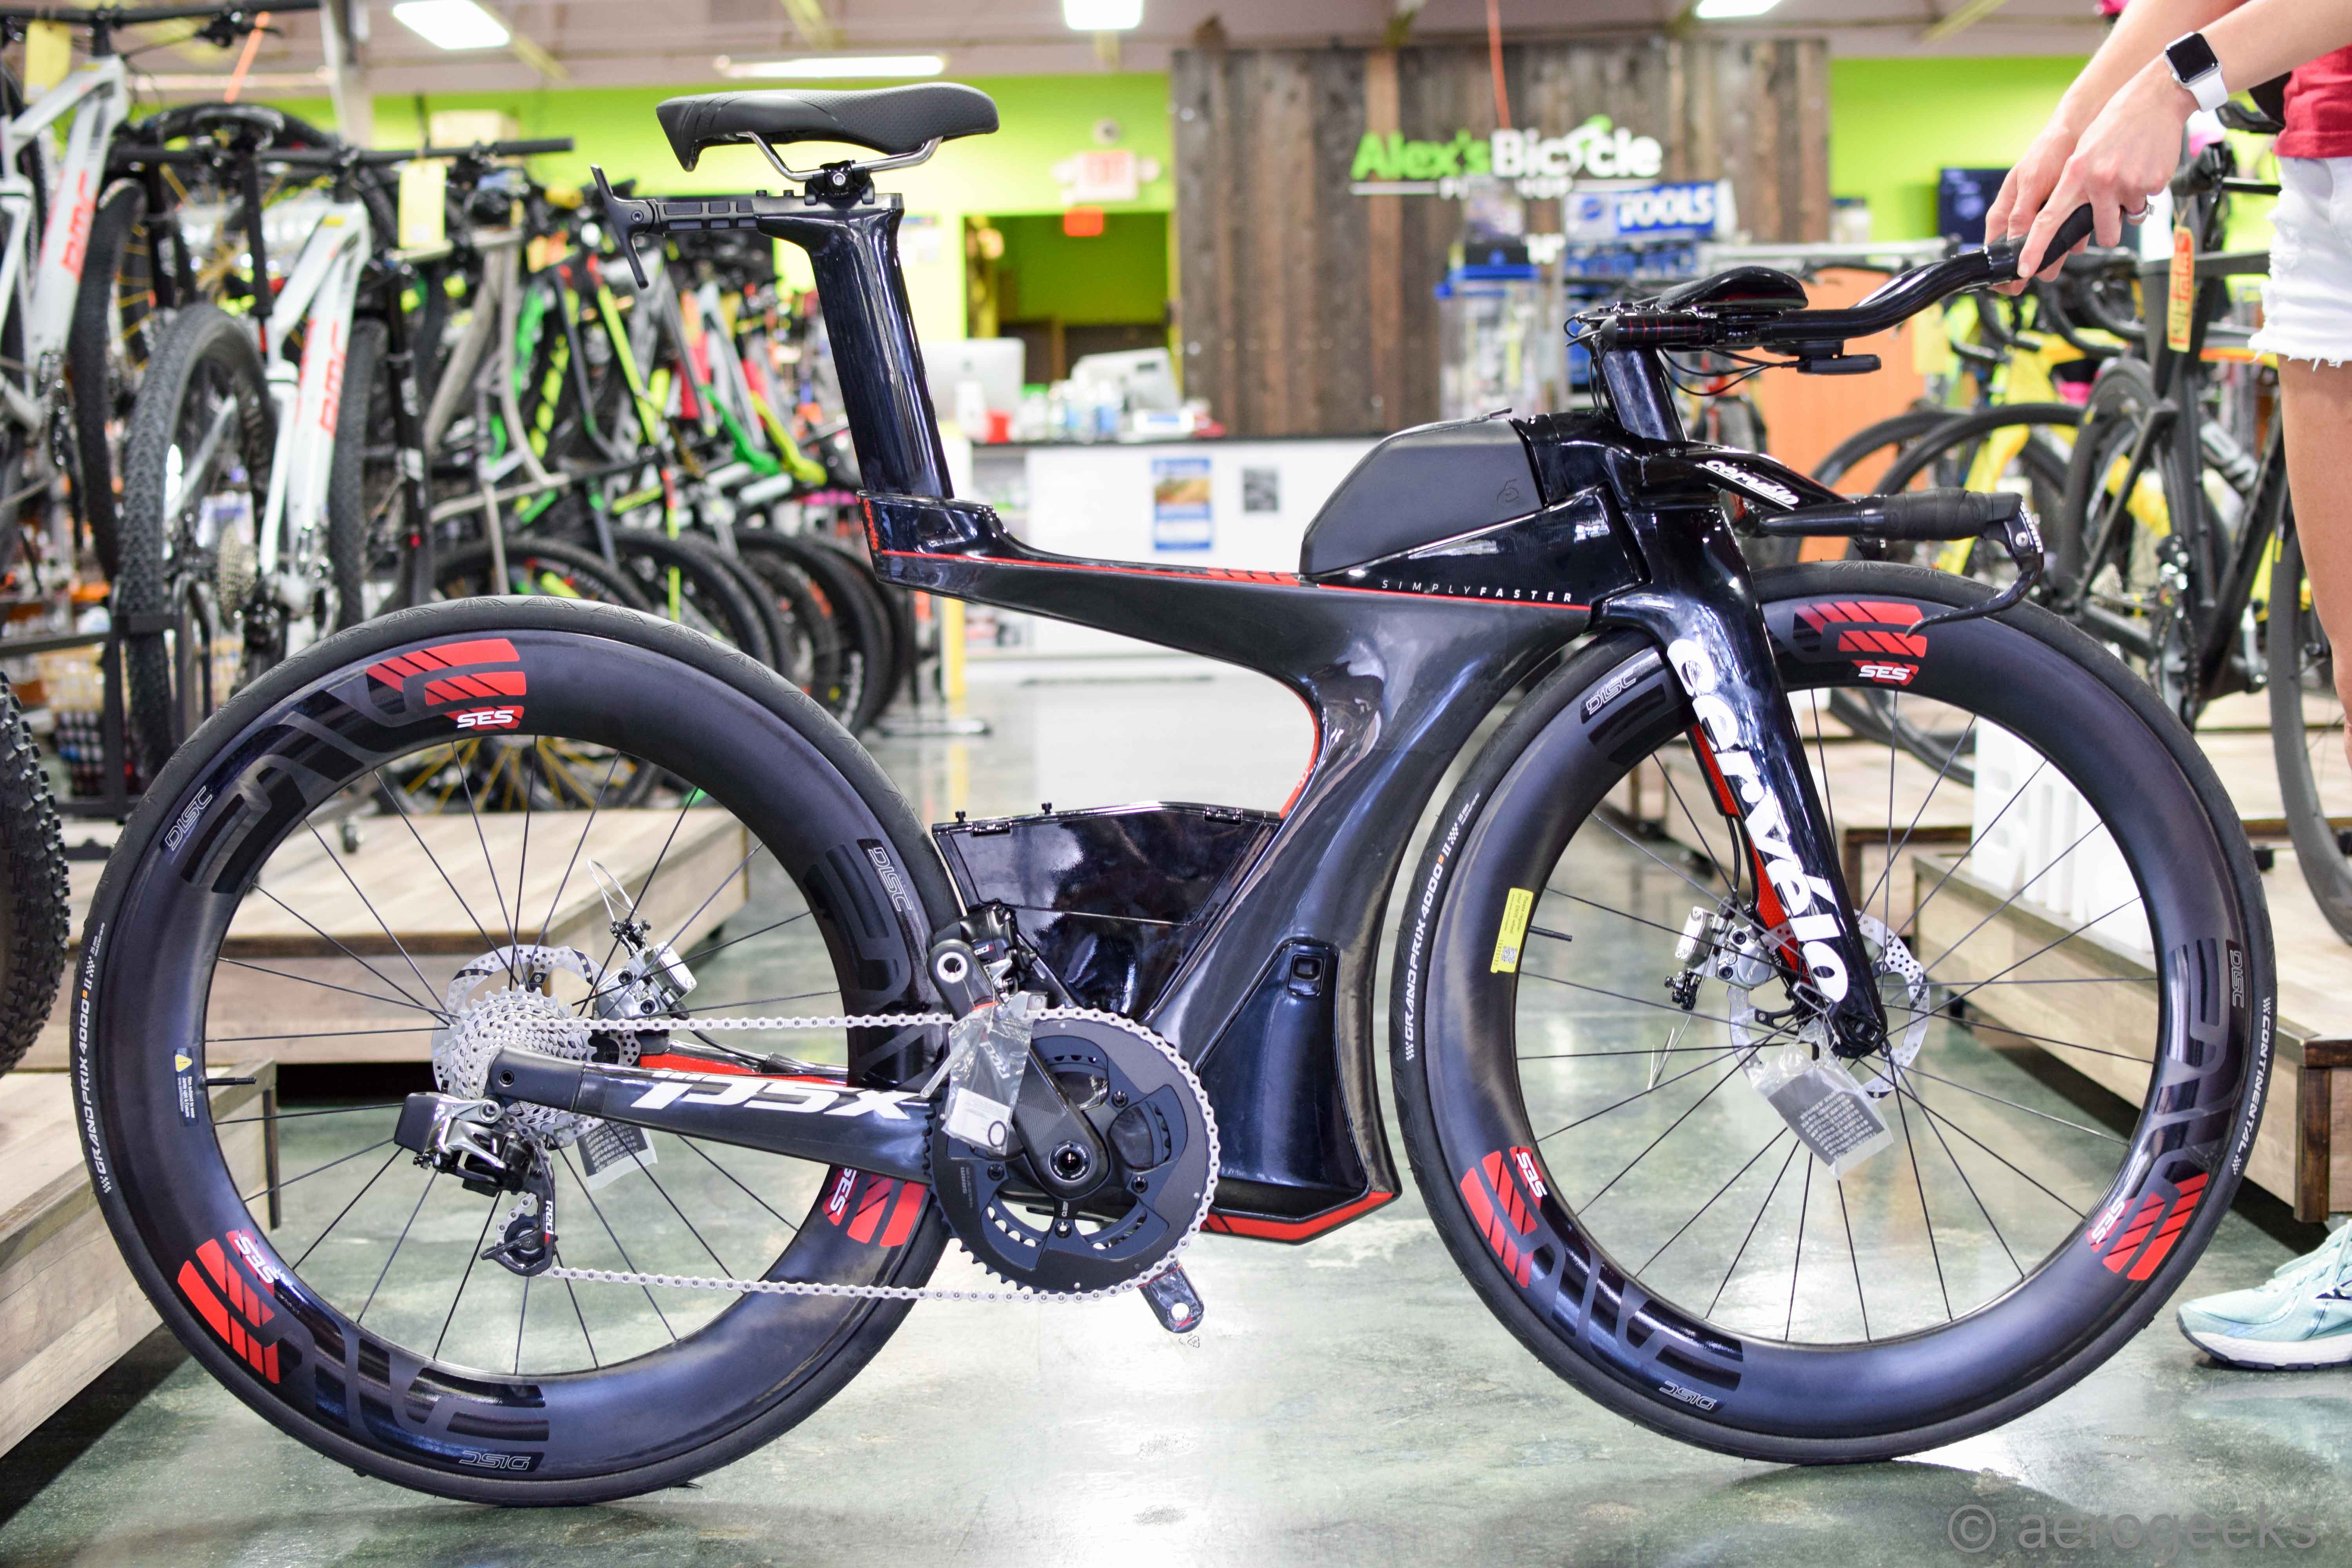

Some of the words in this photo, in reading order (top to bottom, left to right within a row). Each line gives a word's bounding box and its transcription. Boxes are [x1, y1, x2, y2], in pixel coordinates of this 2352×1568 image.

[1349, 128, 1491, 180] Alex's
[1490, 117, 1663, 178] Bicycle
[1617, 185, 1713, 226] TOOLS
[1585, 664, 1636, 715] DISC
[1858, 665, 1909, 681] SES
[457, 710, 514, 728] SES
[165, 786, 213, 851] DISC
[869, 846, 912, 912] DISC
[1410, 918, 1425, 969] PRIX
[2231, 949, 2244, 1008] DISC
[1405, 969, 1416, 1041] GRAND
[80, 1056, 92, 1105] PRIX
[2237, 1014, 2271, 1161] CONTINENTAL
[84, 1107, 106, 1174] GRAND
[1516, 1152, 1547, 1198] SES
[2091, 1199, 2125, 1245] SES
[237, 1233, 276, 1284] SES
[1658, 1381, 1717, 1411] DISC
[459, 1452, 531, 1471] DISC
